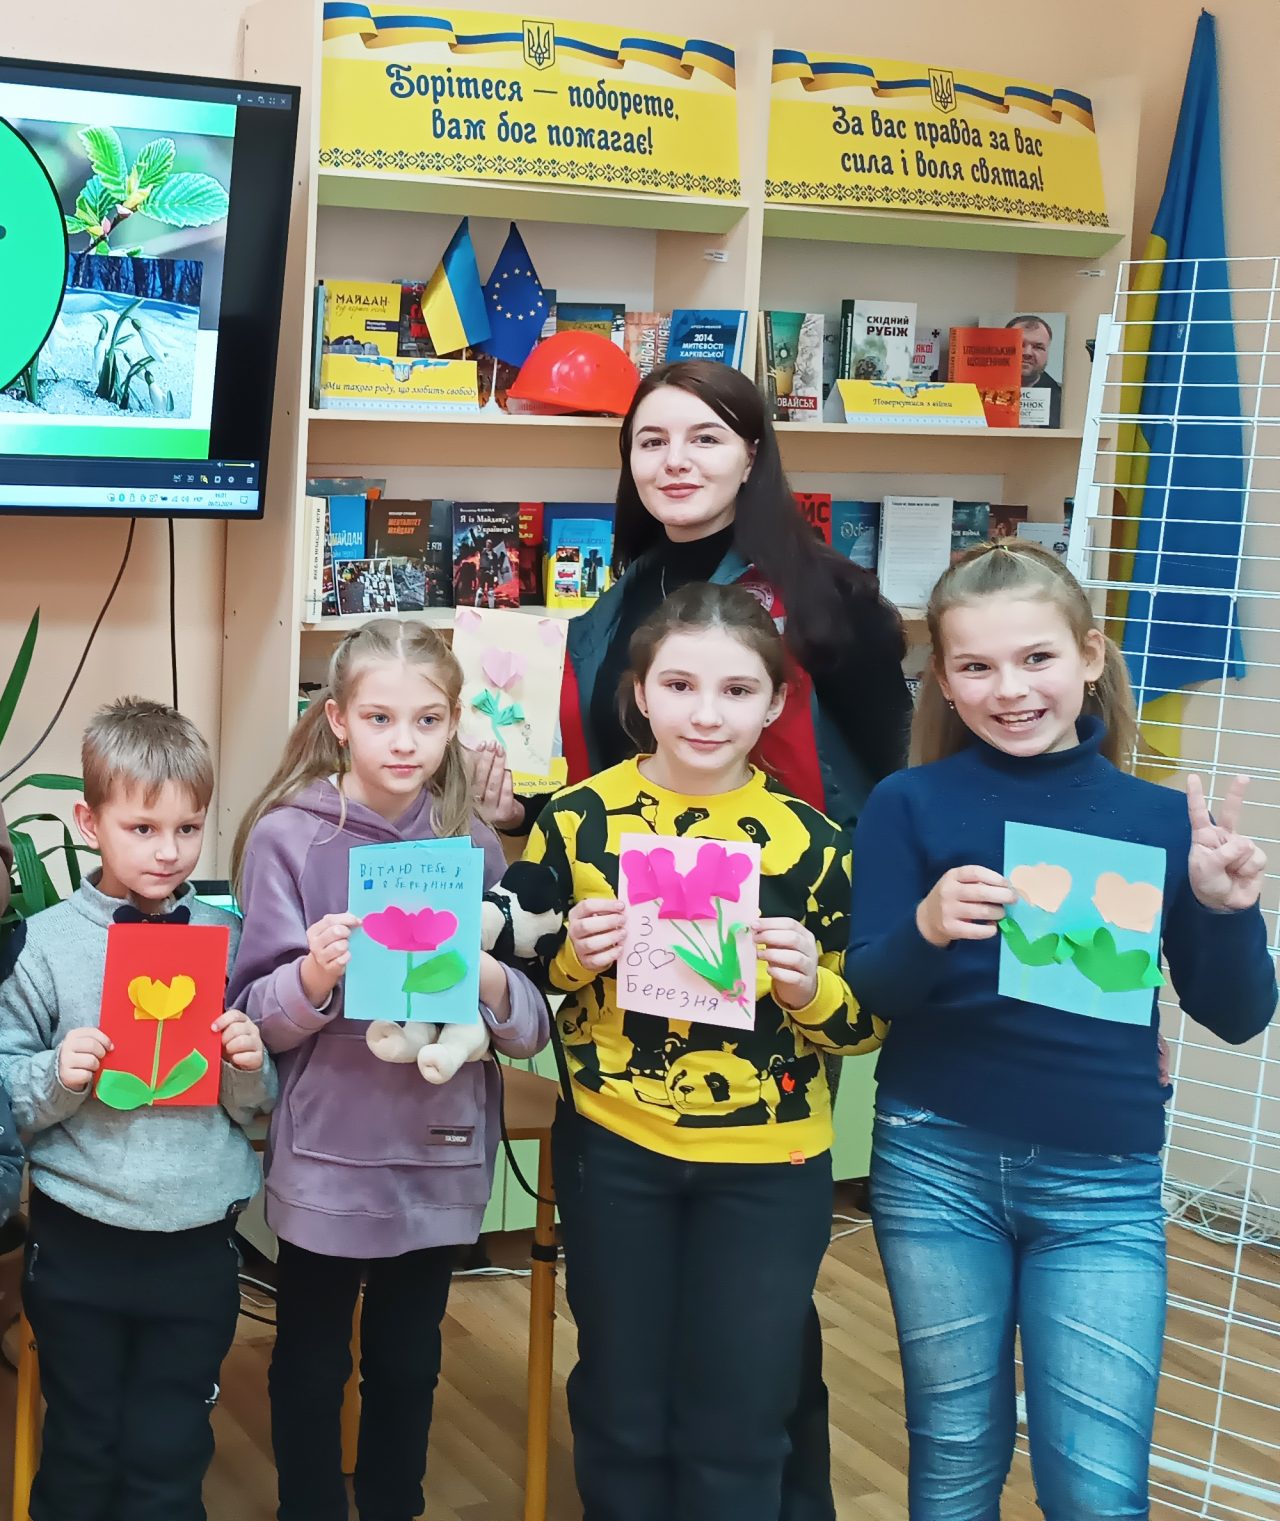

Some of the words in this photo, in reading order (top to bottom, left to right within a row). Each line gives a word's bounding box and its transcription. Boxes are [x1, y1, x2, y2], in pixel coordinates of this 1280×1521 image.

[386, 63, 523, 104] Борітеся
[568, 79, 679, 121] поборете,
[431, 109, 486, 140] вам
[497, 111, 536, 143] бог
[547, 126, 653, 156] помагає!
[832, 105, 864, 136] За
[915, 118, 983, 149] правда
[989, 131, 1010, 152] за
[841, 151, 894, 175] сила
[900, 149, 909, 177] і
[917, 151, 963, 181] воля
[971, 157, 1044, 192] святая!
[866, 315, 909, 325] СХІДНИЙ
[866, 326, 908, 337] РУБІЖ
[639, 329, 656, 382] РАЇНСЬКА
[343, 384, 373, 392] такого
[412, 385, 445, 394] любить
[777, 397, 815, 409] ОВАЙСЬК
[460, 515, 467, 523] Я
[360, 863, 412, 878] ВІТАЮ
[626, 942, 650, 967] 8
[626, 974, 719, 1012] Березня
